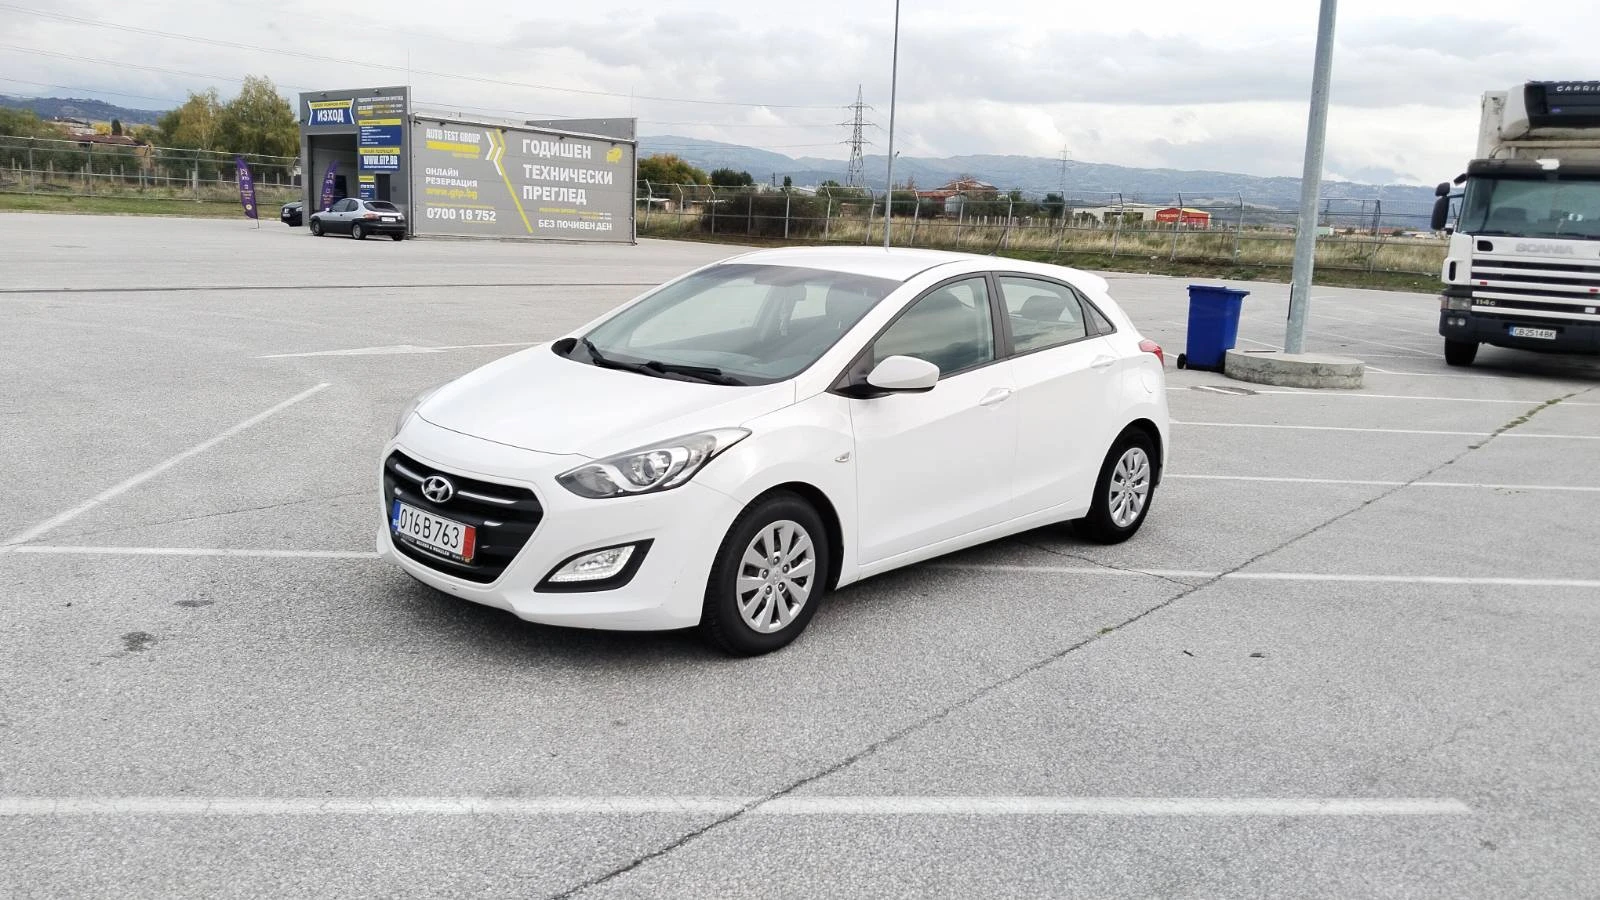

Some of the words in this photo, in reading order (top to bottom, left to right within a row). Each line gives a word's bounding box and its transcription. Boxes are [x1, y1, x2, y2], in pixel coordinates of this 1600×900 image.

[317, 109, 344, 123] ИЗХОД
[426, 128, 443, 140] AUTO
[444, 130, 458, 141] TEST
[522, 138, 592, 160] ГОДИШЕН
[363, 155, 398, 165] WWW.GTP.BG
[425, 167, 459, 177] ОНЛАЙН
[522, 164, 613, 185] ТЕХНИЧЕСКИ
[425, 177, 478, 188] РЕЗЕРВАЦИЯ
[522, 185, 587, 206] ПРЕГЛЕД
[426, 207, 456, 219] 0700
[459, 209, 473, 220] 18
[475, 210, 497, 221] 752
[538, 219, 555, 228] БЕЗ
[556, 220, 595, 230] ПОЧИВЕН
[596, 222, 613, 231] ДЕН
[1515, 243, 1574, 254] SCANIA
[400, 508, 460, 549] 016B763
